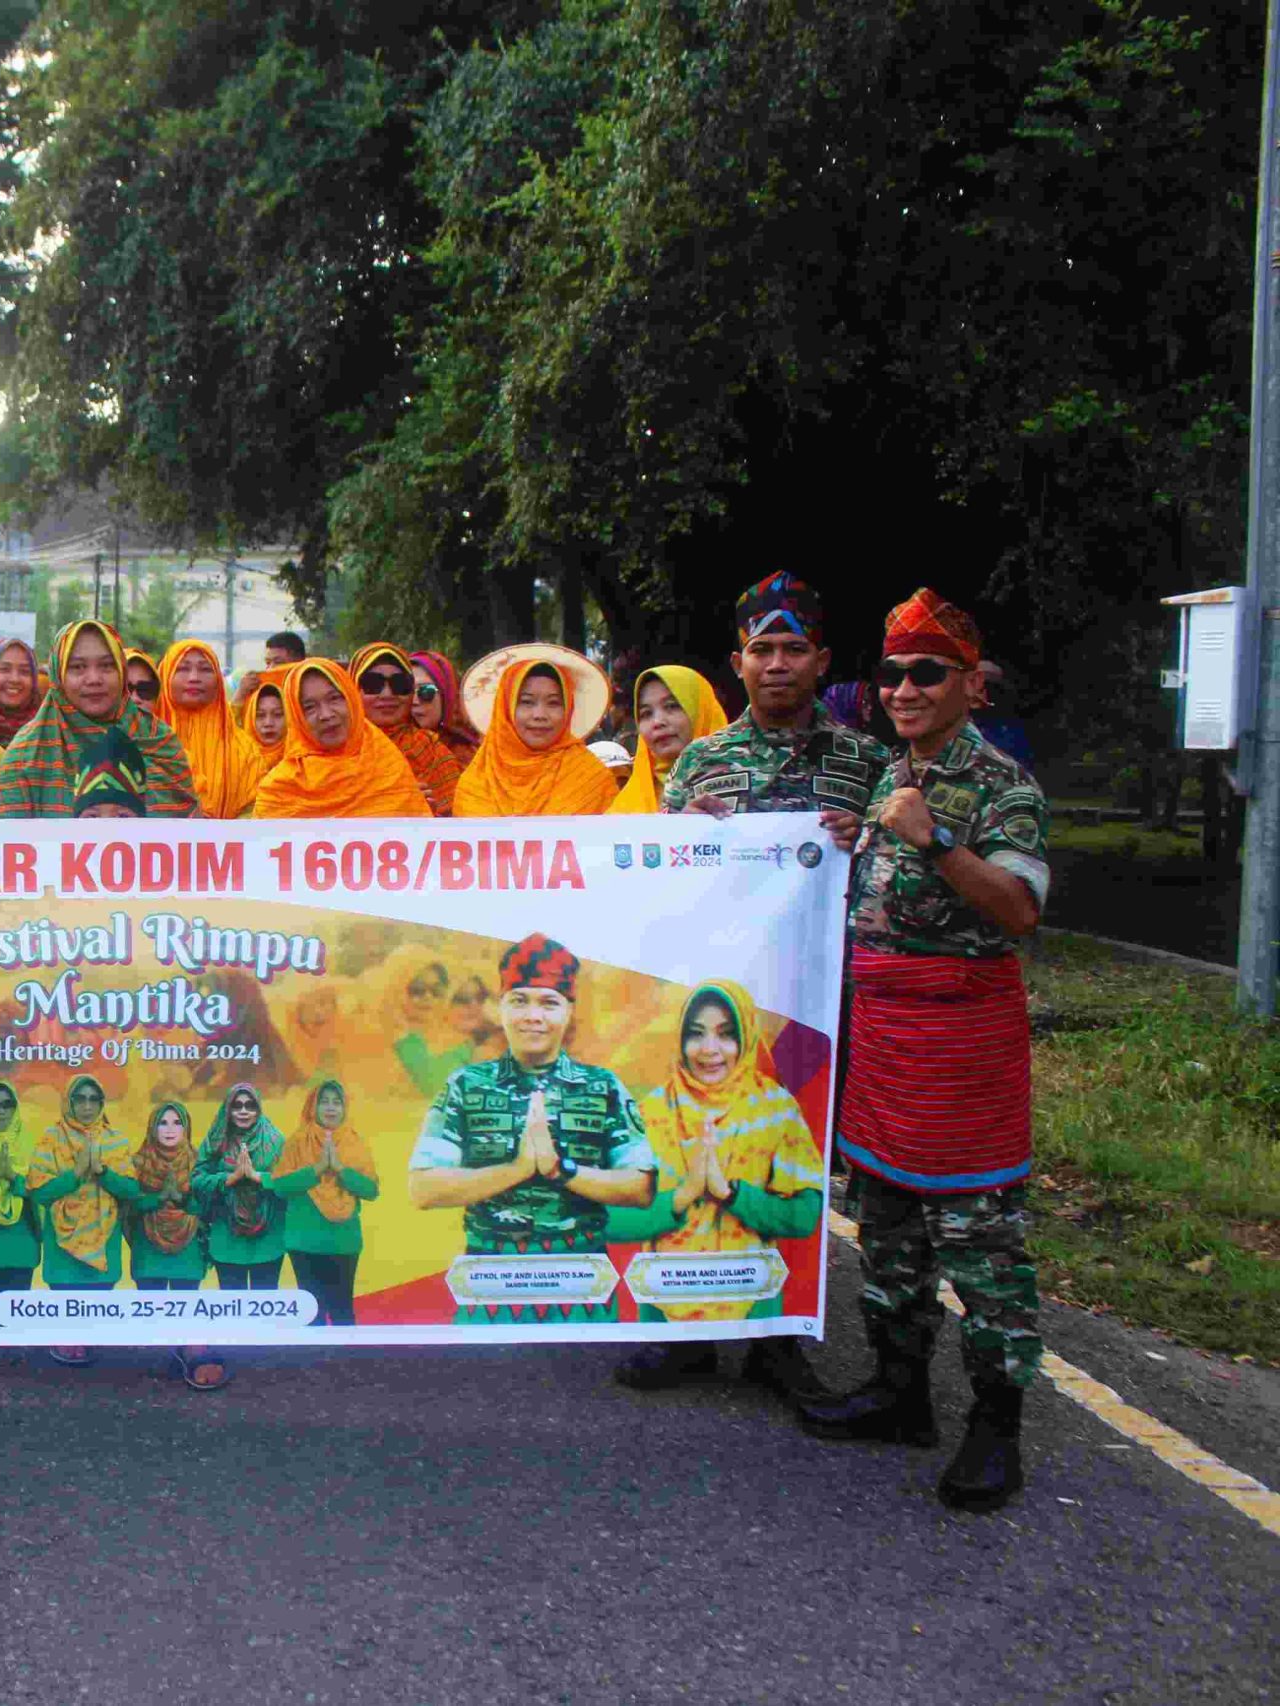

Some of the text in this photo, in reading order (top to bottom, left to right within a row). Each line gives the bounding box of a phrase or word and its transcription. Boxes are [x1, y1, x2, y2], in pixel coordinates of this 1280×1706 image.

[693, 844, 721, 856] KEN
[693, 857, 721, 867] 2024
[61, 842, 244, 892] KODIM
[269, 840, 586, 890] 1608/BIMA
[140, 912, 327, 981] Rimpu
[14, 968, 236, 1036] Mantika
[101, 1039, 132, 1066] Of
[135, 1040, 199, 1062] Bima
[206, 1046, 261, 1065] 2024
[699, 1269, 718, 1277] ANDI
[10, 1299, 299, 1320] Kota Bima, 25-27 April 2024
